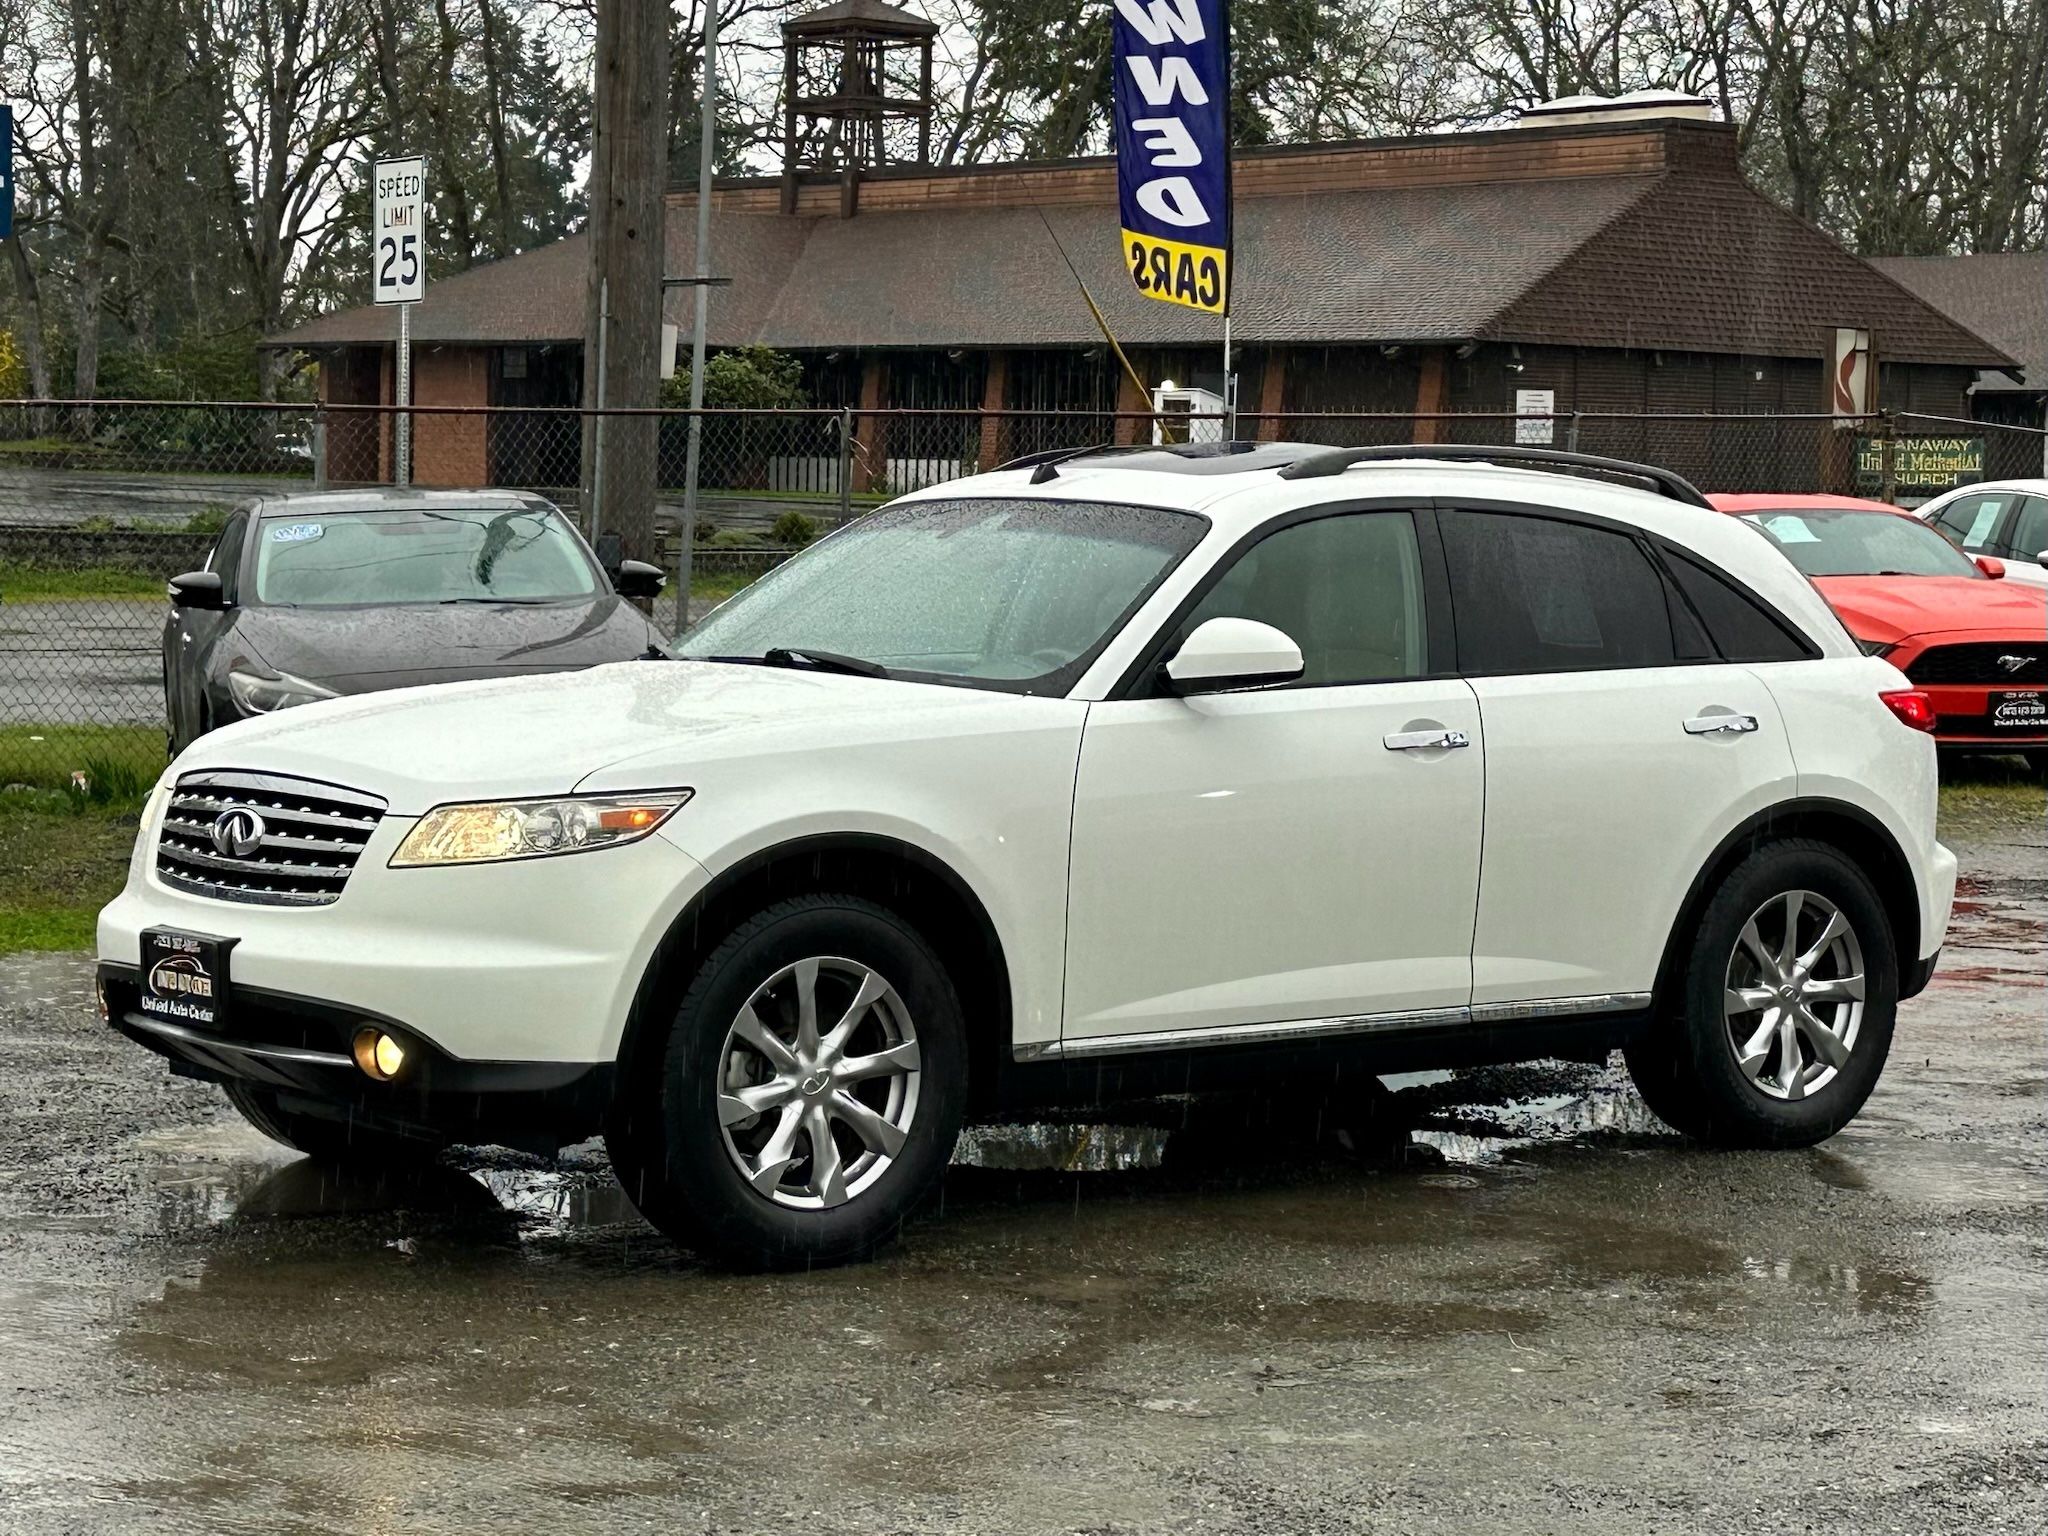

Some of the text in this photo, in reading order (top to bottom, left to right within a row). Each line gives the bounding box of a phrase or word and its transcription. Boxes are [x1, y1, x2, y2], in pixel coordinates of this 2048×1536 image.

[379, 176, 420, 199] SPEED
[383, 205, 415, 228] LIMIT
[380, 235, 418, 287] 25
[1870, 438, 1972, 452] SANAWAY
[1858, 452, 1906, 470] Unid
[1890, 472, 1958, 485] HURCH
